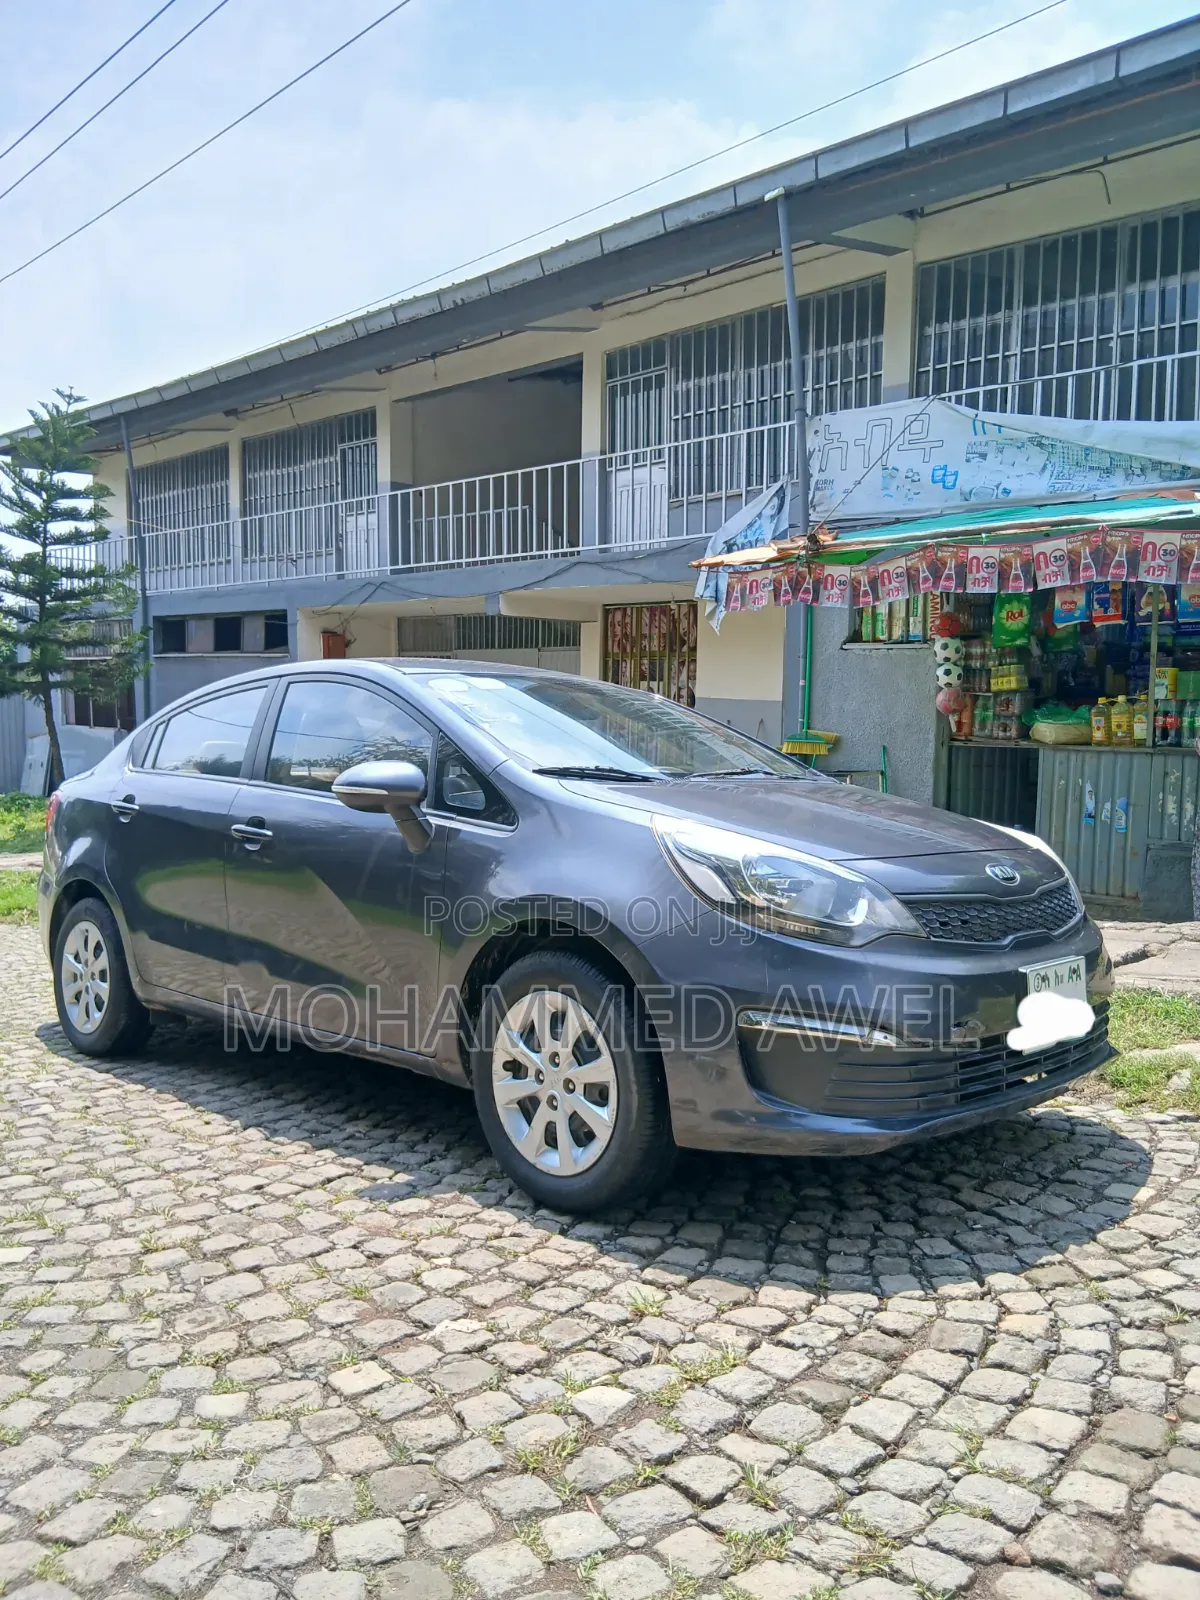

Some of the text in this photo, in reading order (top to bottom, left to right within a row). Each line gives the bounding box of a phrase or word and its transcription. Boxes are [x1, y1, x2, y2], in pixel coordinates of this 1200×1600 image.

[1161, 549, 1176, 557] 30
[1052, 555, 1065, 563] 30
[894, 571, 905, 579] 30
[1062, 602, 1076, 610] abc
[1005, 608, 1025, 622] Rol
